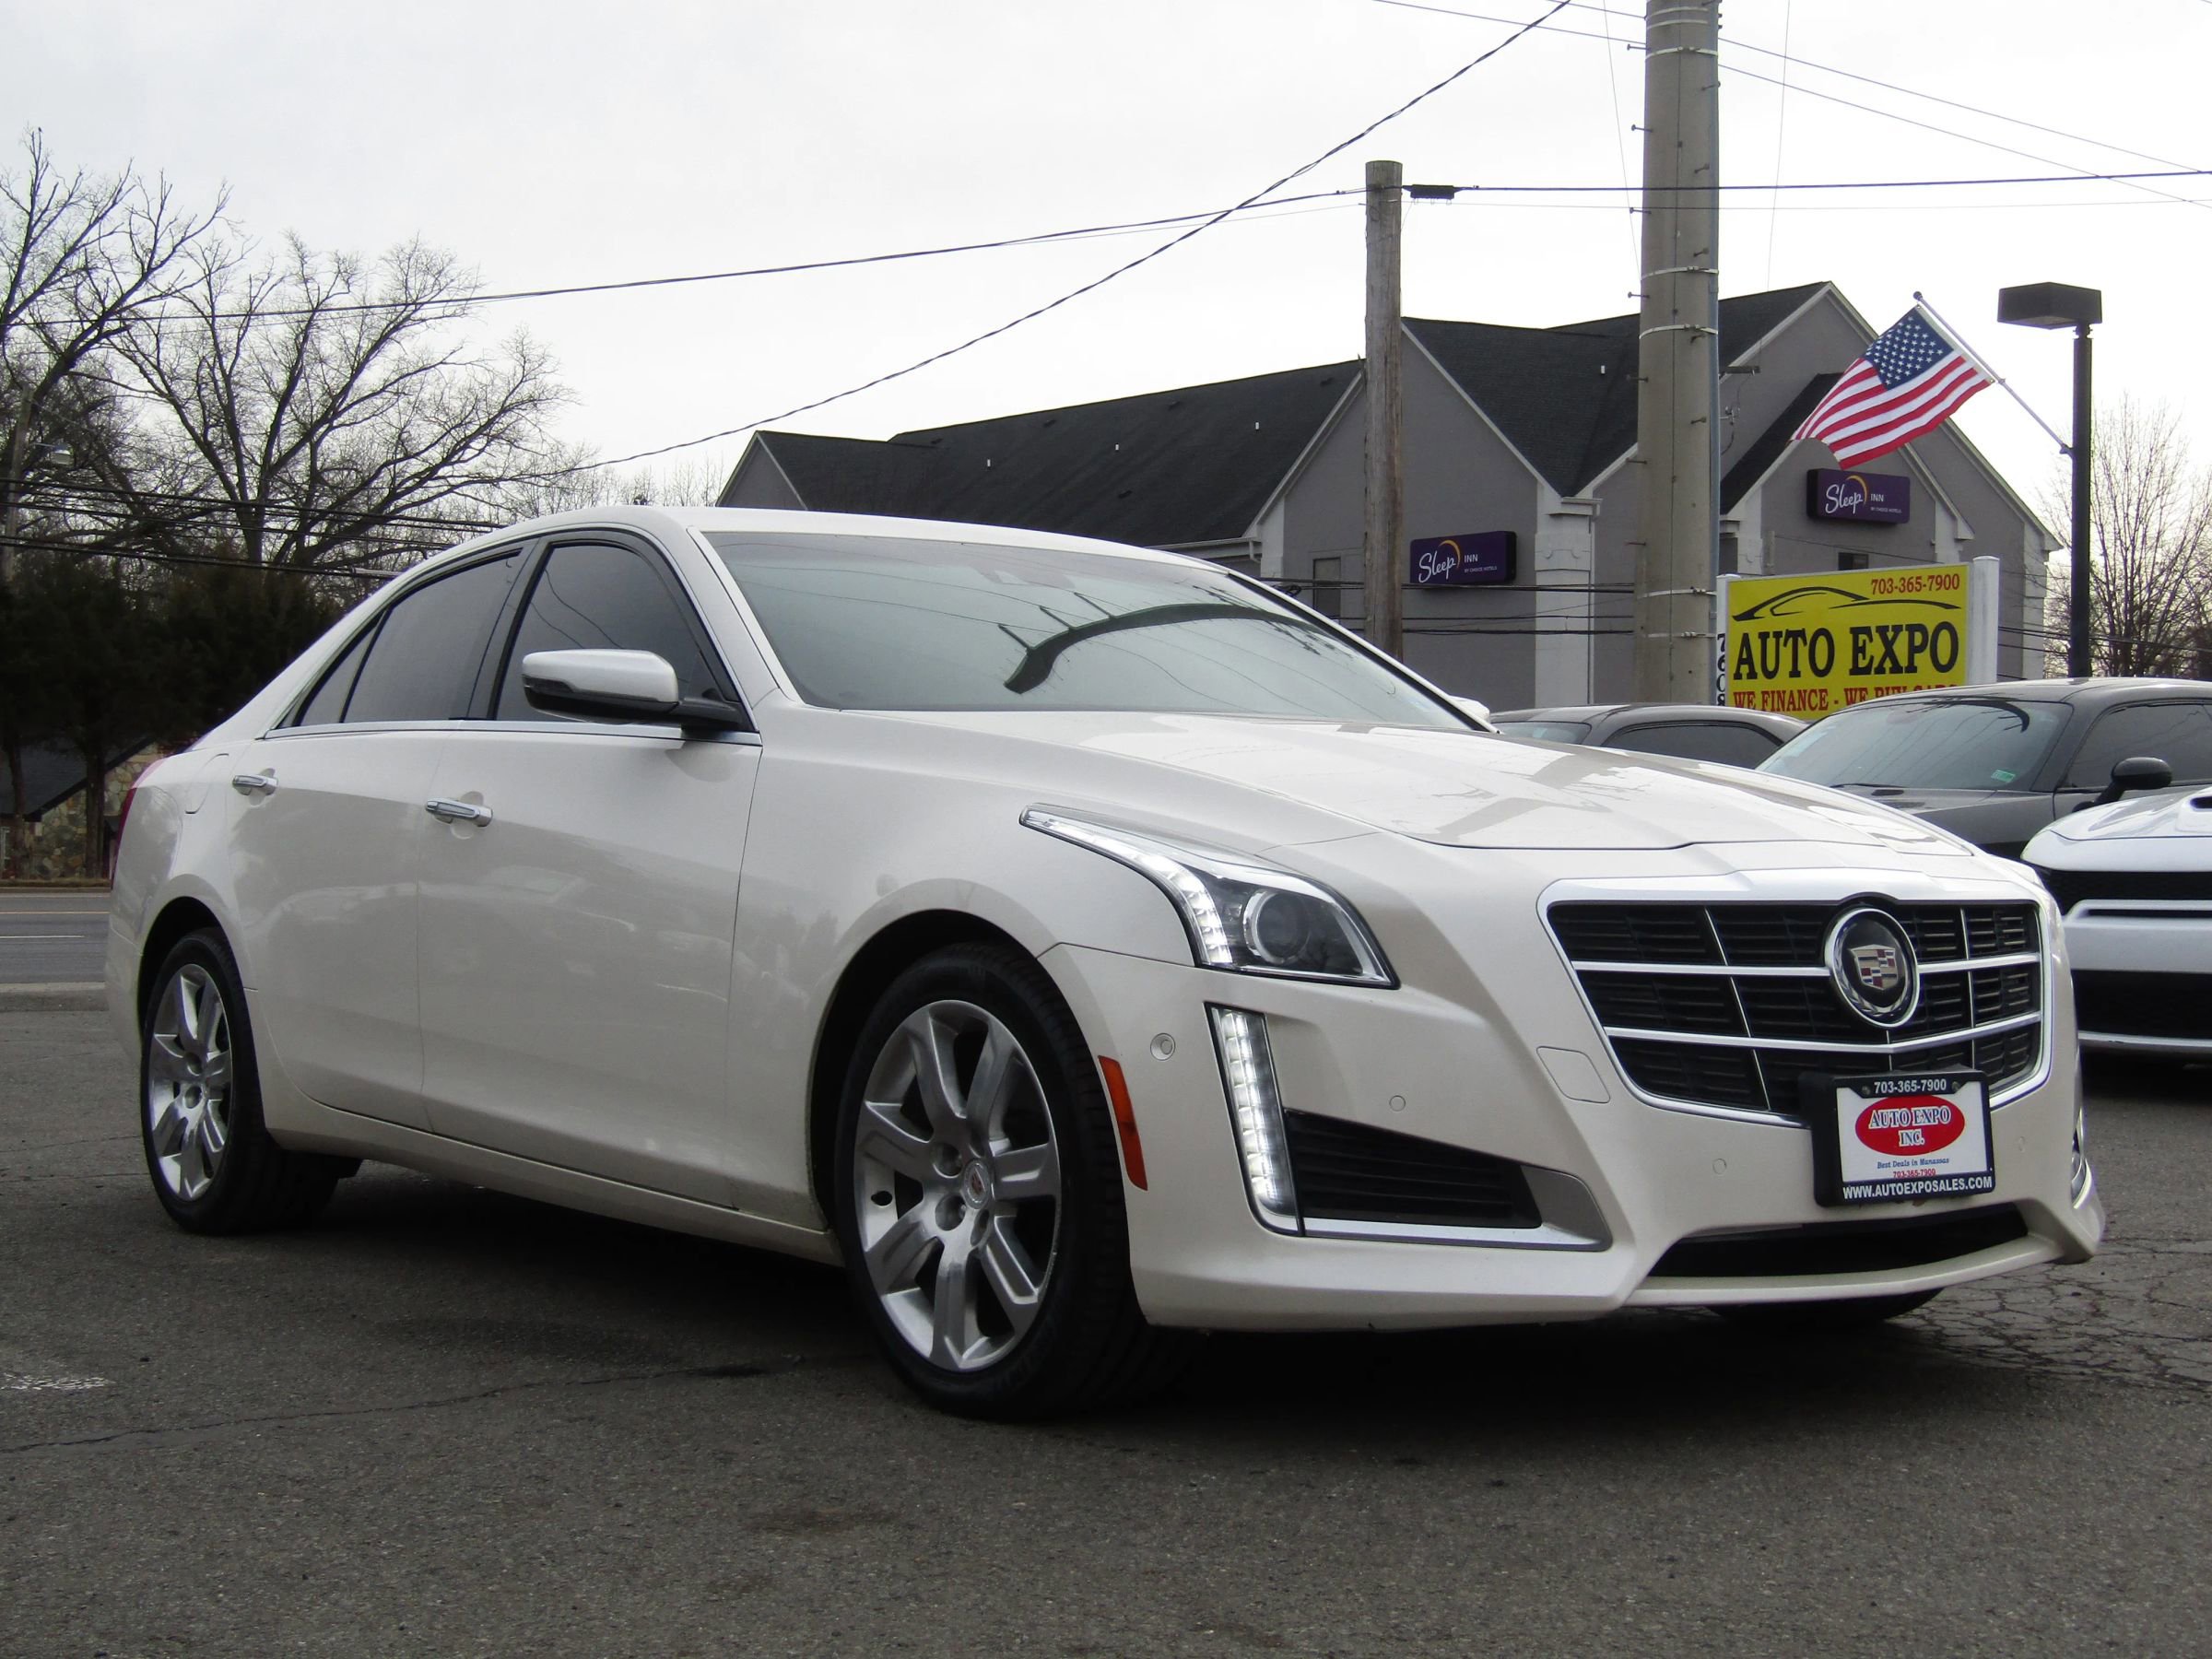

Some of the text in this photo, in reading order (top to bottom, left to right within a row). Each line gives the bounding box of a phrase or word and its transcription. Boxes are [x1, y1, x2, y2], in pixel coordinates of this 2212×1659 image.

[1825, 484, 1863, 514] Sleep
[1870, 493, 1884, 502] INN
[1418, 550, 1478, 583] Sleep INN
[1871, 573, 1960, 595] 703-365-7900
[1733, 620, 1959, 680] AUTO EXPO
[1733, 690, 1757, 711] WE
[1760, 688, 1830, 712] FINANCE
[1874, 1078, 1947, 1094] 703-365-7900
[1869, 1106, 1951, 1129] AUTO EXPO
[1899, 1129, 1924, 1147] INC.
[1877, 1160, 1891, 1170] Best
[1892, 1159, 1910, 1168] Deals
[1843, 1176, 1993, 1200] WWW.AUTOEXPOSALES.COM
